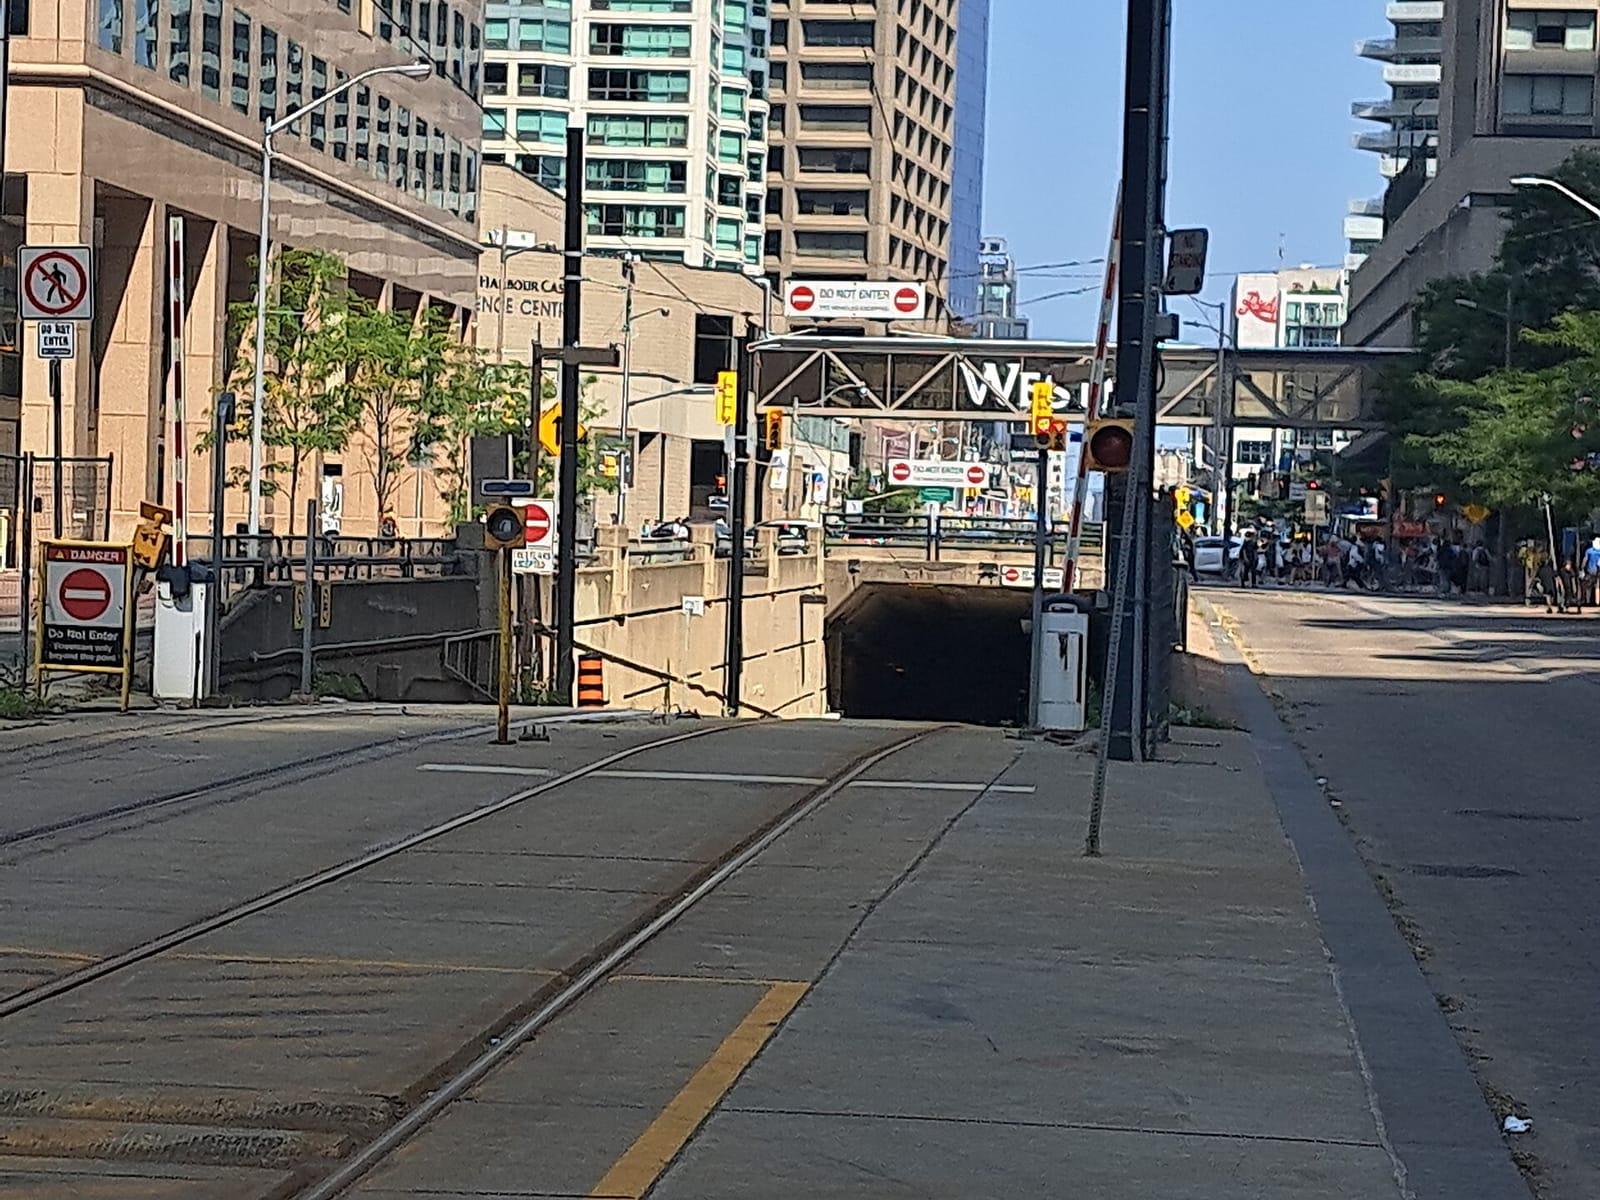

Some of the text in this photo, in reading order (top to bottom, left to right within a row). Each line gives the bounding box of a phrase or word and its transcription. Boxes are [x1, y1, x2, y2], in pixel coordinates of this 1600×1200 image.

[820, 288, 889, 300] DO NOT ENTER
[70, 550, 119, 562] DANGER
[48, 628, 119, 641] Do Not Enter
